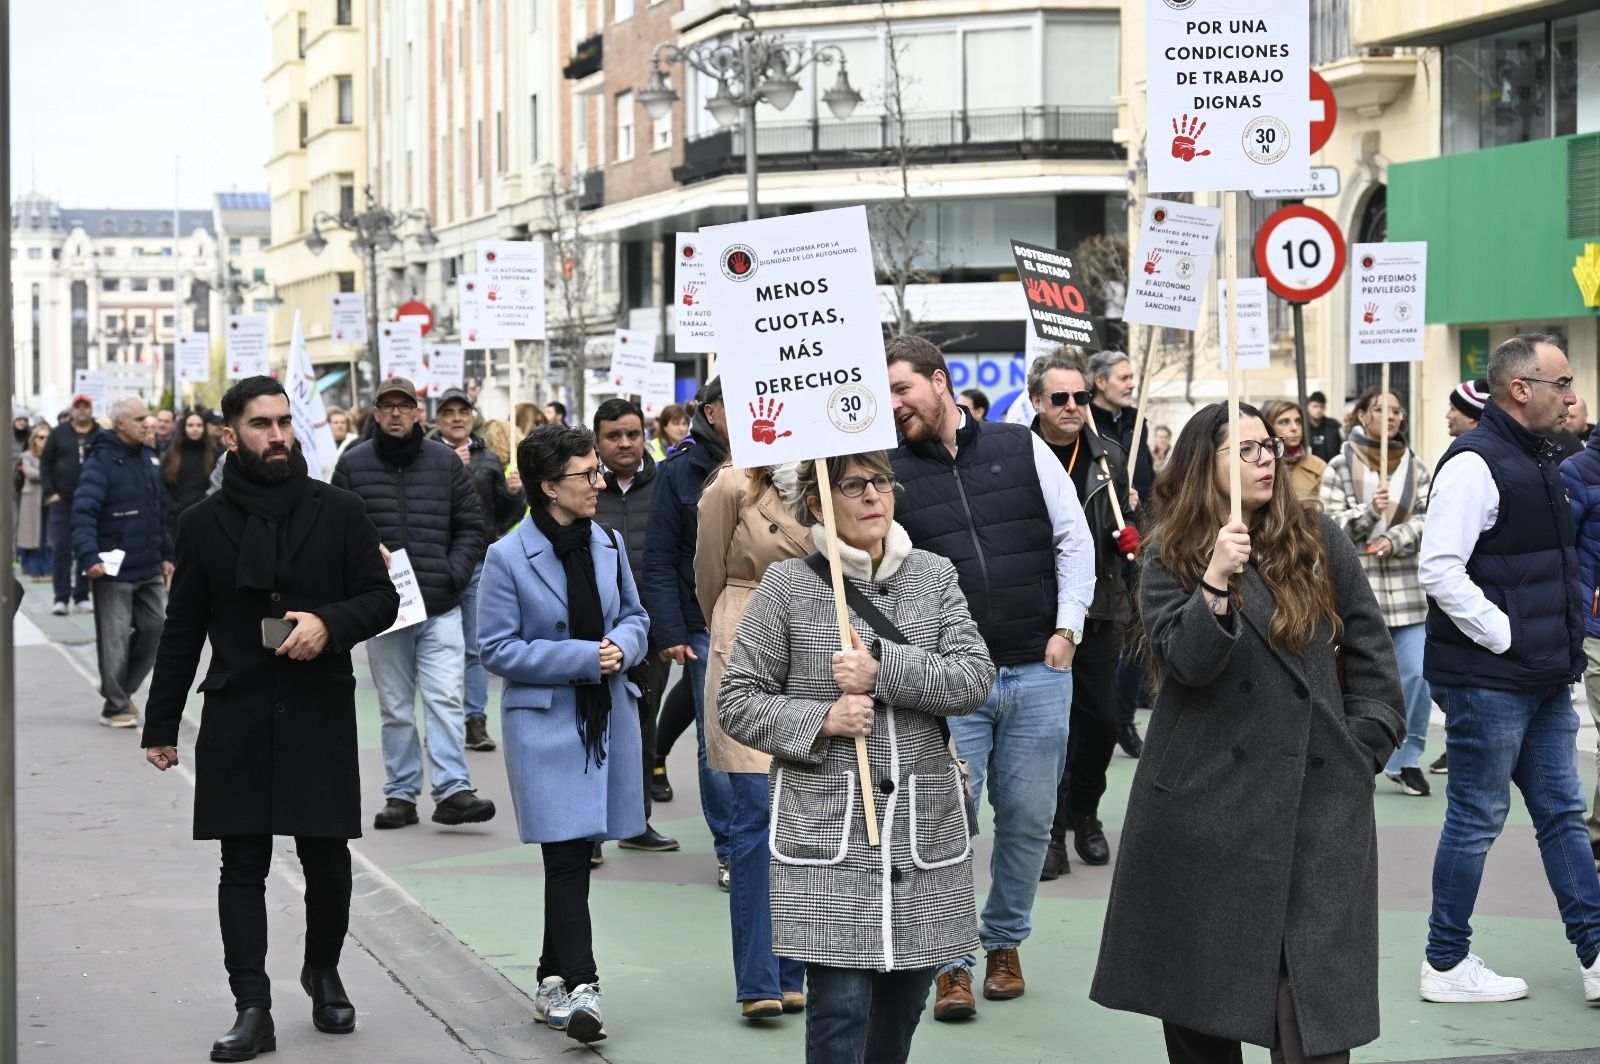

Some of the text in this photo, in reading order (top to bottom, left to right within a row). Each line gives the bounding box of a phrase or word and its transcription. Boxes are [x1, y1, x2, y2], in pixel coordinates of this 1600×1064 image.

[1186, 19, 1268, 35] POR UNA
[1164, 44, 1290, 60] CONDICIONES
[1176, 69, 1284, 85] DE TRABAJO
[1194, 95, 1262, 109] DIGNAS
[1255, 128, 1276, 144] 30
[1261, 144, 1270, 154] N
[1149, 225, 1180, 236] Mientras
[759, 256, 791, 266] DIGNIDAD
[792, 254, 801, 262] DE
[815, 247, 858, 258] AUTONOMOS
[773, 244, 815, 255] PLATAFORMA
[1014, 245, 1073, 268] SOSTENEMOS
[1282, 239, 1321, 270] 10
[1023, 259, 1070, 279] EL ESTADO
[1181, 262, 1190, 270] 30
[1361, 273, 1417, 283] NO PEDIMOS
[756, 277, 829, 302] MENOS
[1039, 279, 1085, 314] NO
[1135, 289, 1164, 298] TRABAJA
[1178, 294, 1196, 302] PAGA
[1361, 285, 1417, 294] PRIVILEGIOS
[1144, 301, 1182, 312] SANCIONES
[754, 308, 845, 333] CUOTAS,
[1032, 308, 1093, 331] MANTENEMOS
[1041, 323, 1091, 343] PARÁSITOS
[779, 338, 824, 361] MÁS
[754, 367, 862, 396] DERECHOS
[840, 395, 862, 412] 30
[848, 412, 857, 422] N
